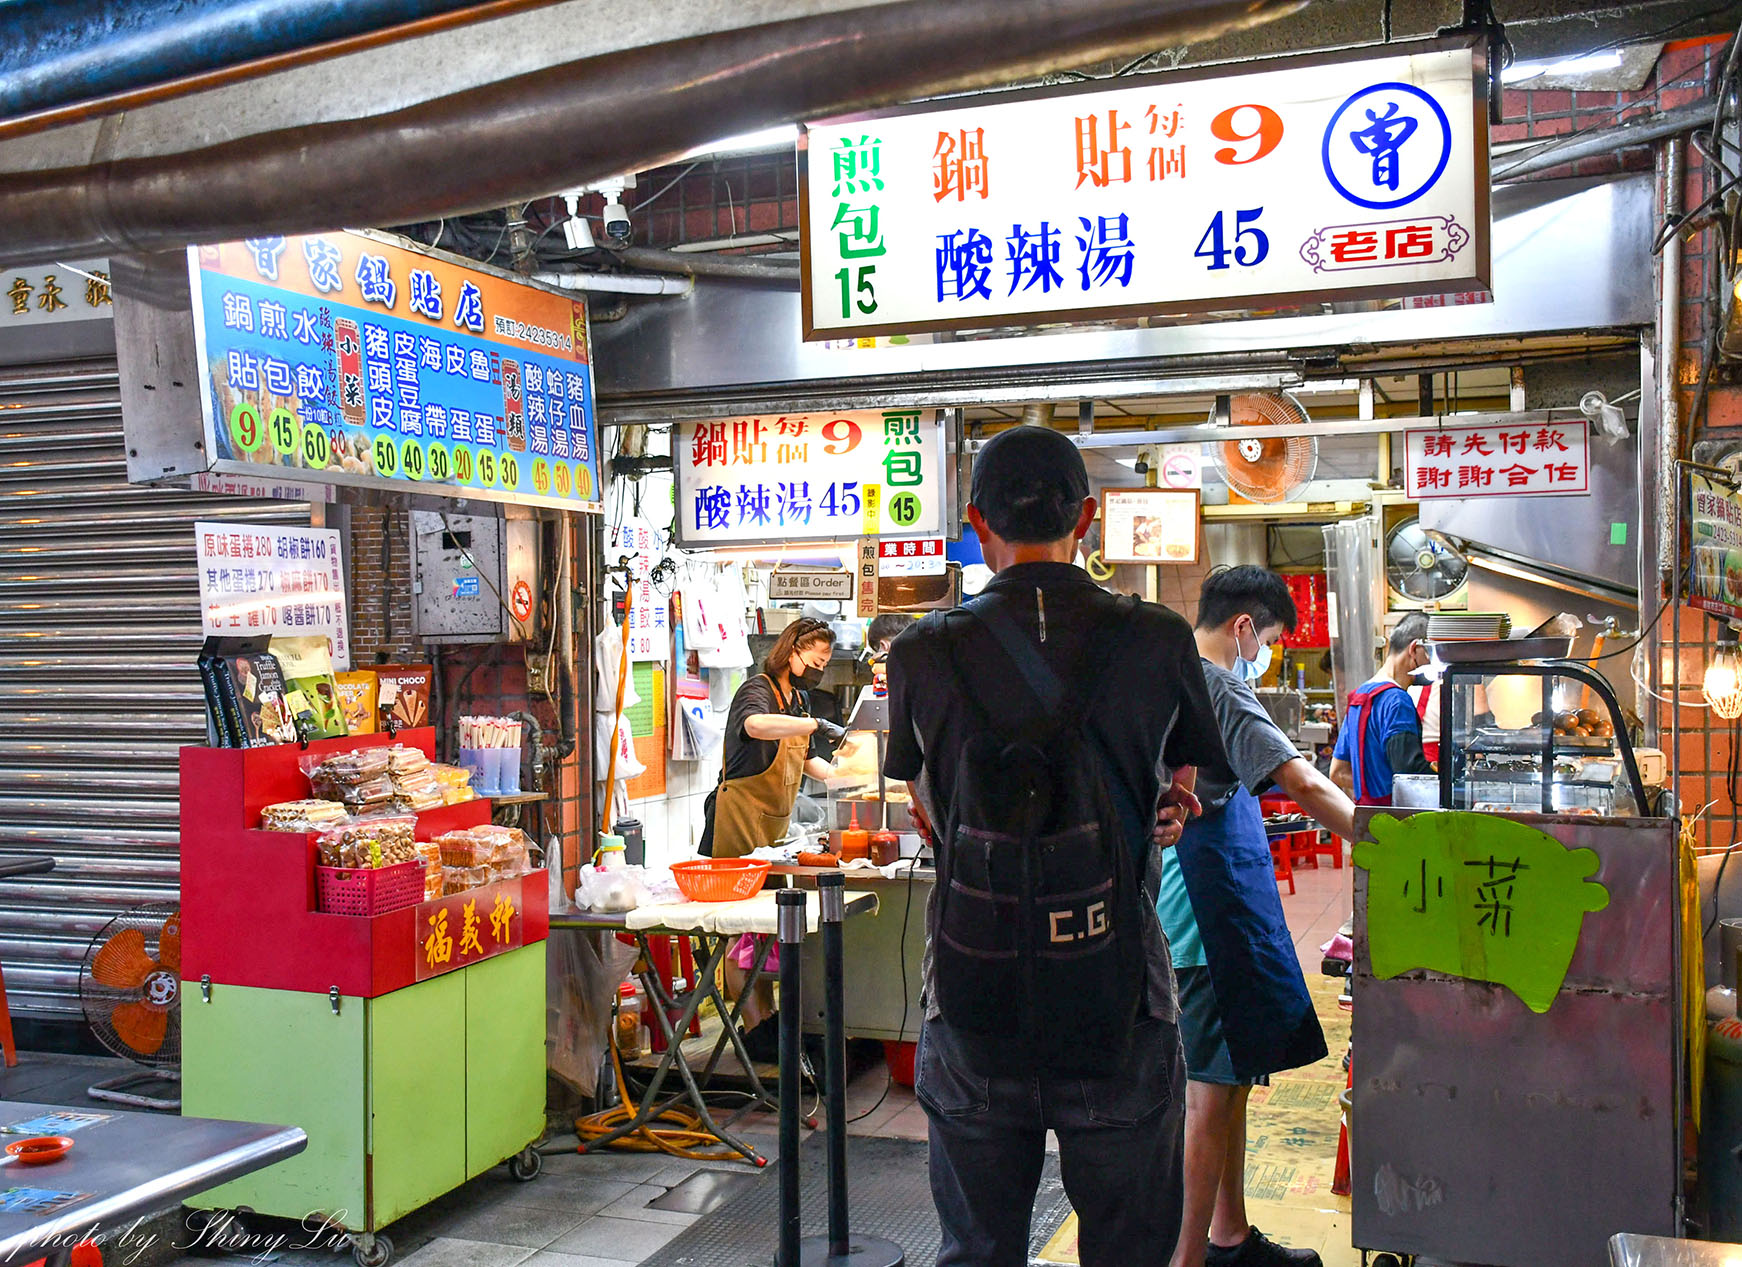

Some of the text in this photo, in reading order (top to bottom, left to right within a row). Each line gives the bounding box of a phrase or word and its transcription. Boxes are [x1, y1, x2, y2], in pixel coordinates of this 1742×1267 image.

[1209, 103, 1285, 166] 9
[1350, 101, 1418, 192] 曾
[831, 134, 888, 261] 煎包
[1193, 206, 1269, 272] 45
[1330, 225, 1434, 264] 老店
[934, 211, 1135, 303] 酸辣湯
[247, 234, 487, 334] 曾家鍋貼店
[834, 265, 879, 320] 15
[340, 334, 363, 407] 小菜
[239, 411, 256, 447] 9
[274, 415, 293, 448] 15
[305, 429, 326, 463] 60
[330, 429, 346, 454] 80
[692, 419, 768, 468] 鍋貼
[821, 419, 862, 455] 9
[1424, 429, 1569, 458] 請先付款
[376, 441, 395, 472] 50
[404, 444, 422, 474] 40
[431, 448, 447, 478] 30
[455, 449, 471, 480] 20
[881, 410, 924, 487] 煎包
[480, 454, 493, 482] 15
[502, 457, 517, 486] 30
[535, 462, 548, 490] 45
[556, 465, 569, 493] 50
[578, 468, 590, 496] 40
[1416, 462, 1579, 490] 謝謝合作
[695, 481, 813, 530] 酸辣湯
[819, 481, 861, 517] 45
[893, 497, 915, 521] 15
[884, 541, 936, 556] 業時間
[812, 577, 844, 587] Order
[861, 546, 876, 612] 煎包售完
[380, 676, 426, 685] MINI CHOCO
[1402, 855, 1532, 938] 小菜
[424, 893, 516, 968] 福義軒
